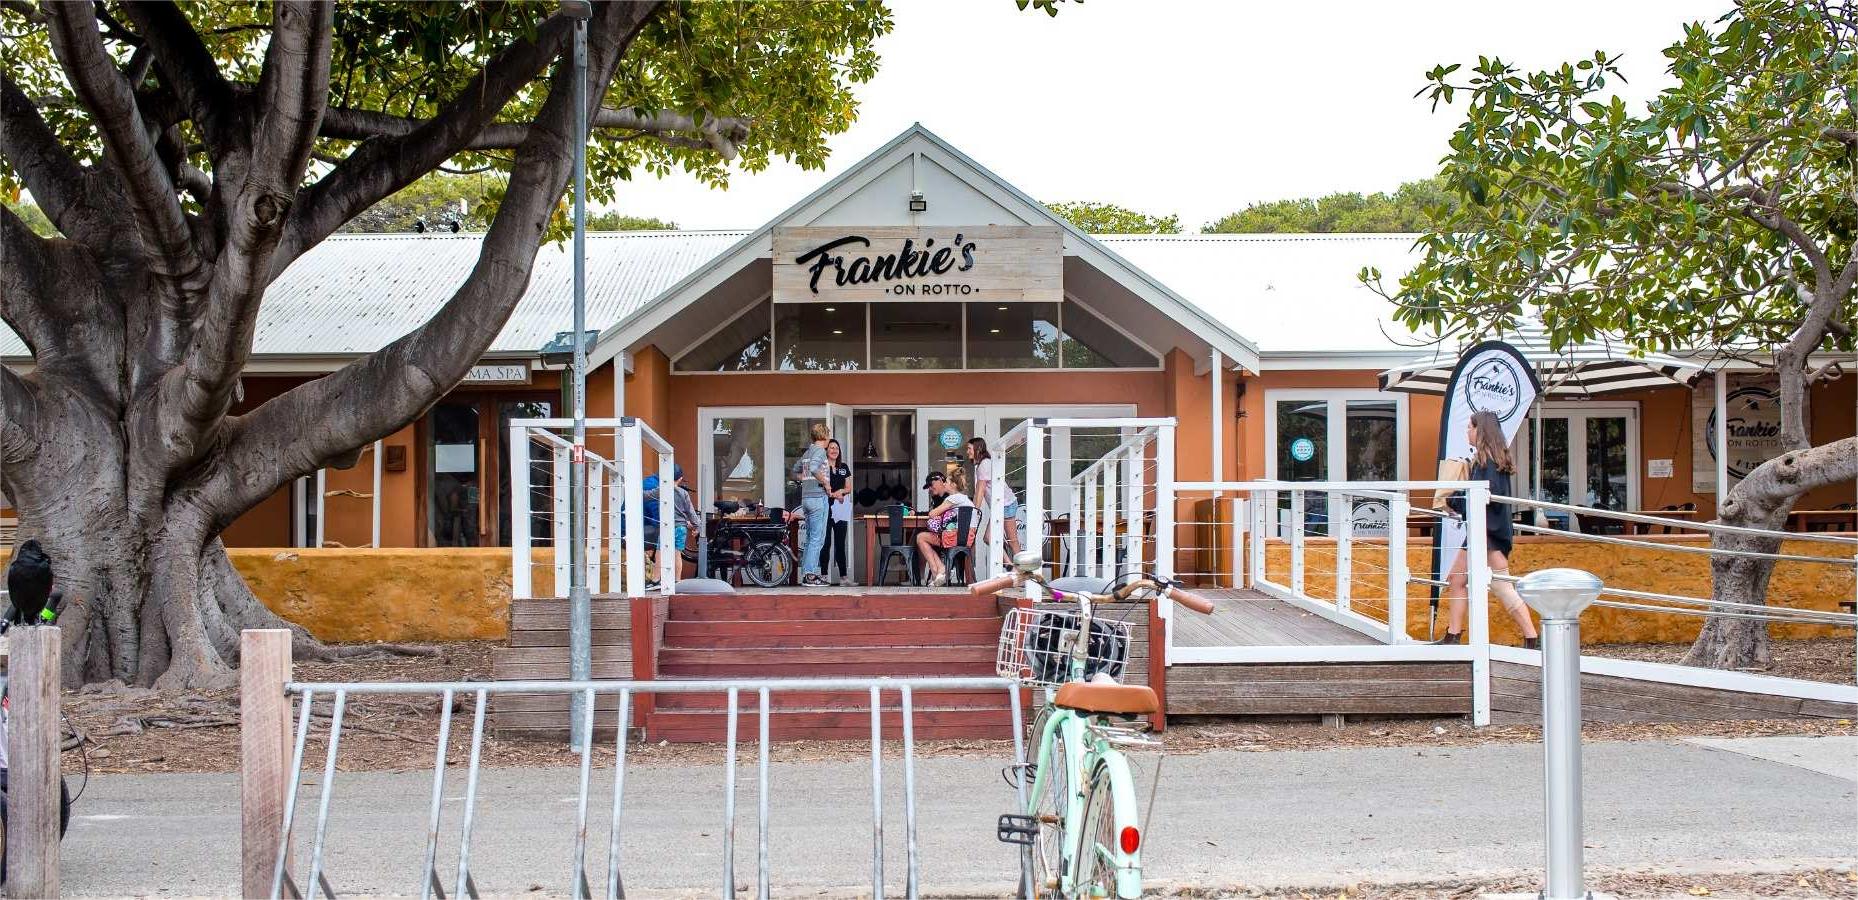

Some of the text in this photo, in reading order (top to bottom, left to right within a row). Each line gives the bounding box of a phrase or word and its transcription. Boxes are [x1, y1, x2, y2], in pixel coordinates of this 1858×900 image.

[796, 234, 976, 294] Frankie's
[893, 284, 972, 296] ON ROTTO
[468, 367, 522, 380] MA SPA
[1473, 376, 1515, 396] Frankie's
[1726, 417, 1781, 437] Frankie'
[1727, 439, 1778, 448] ON ROTTO
